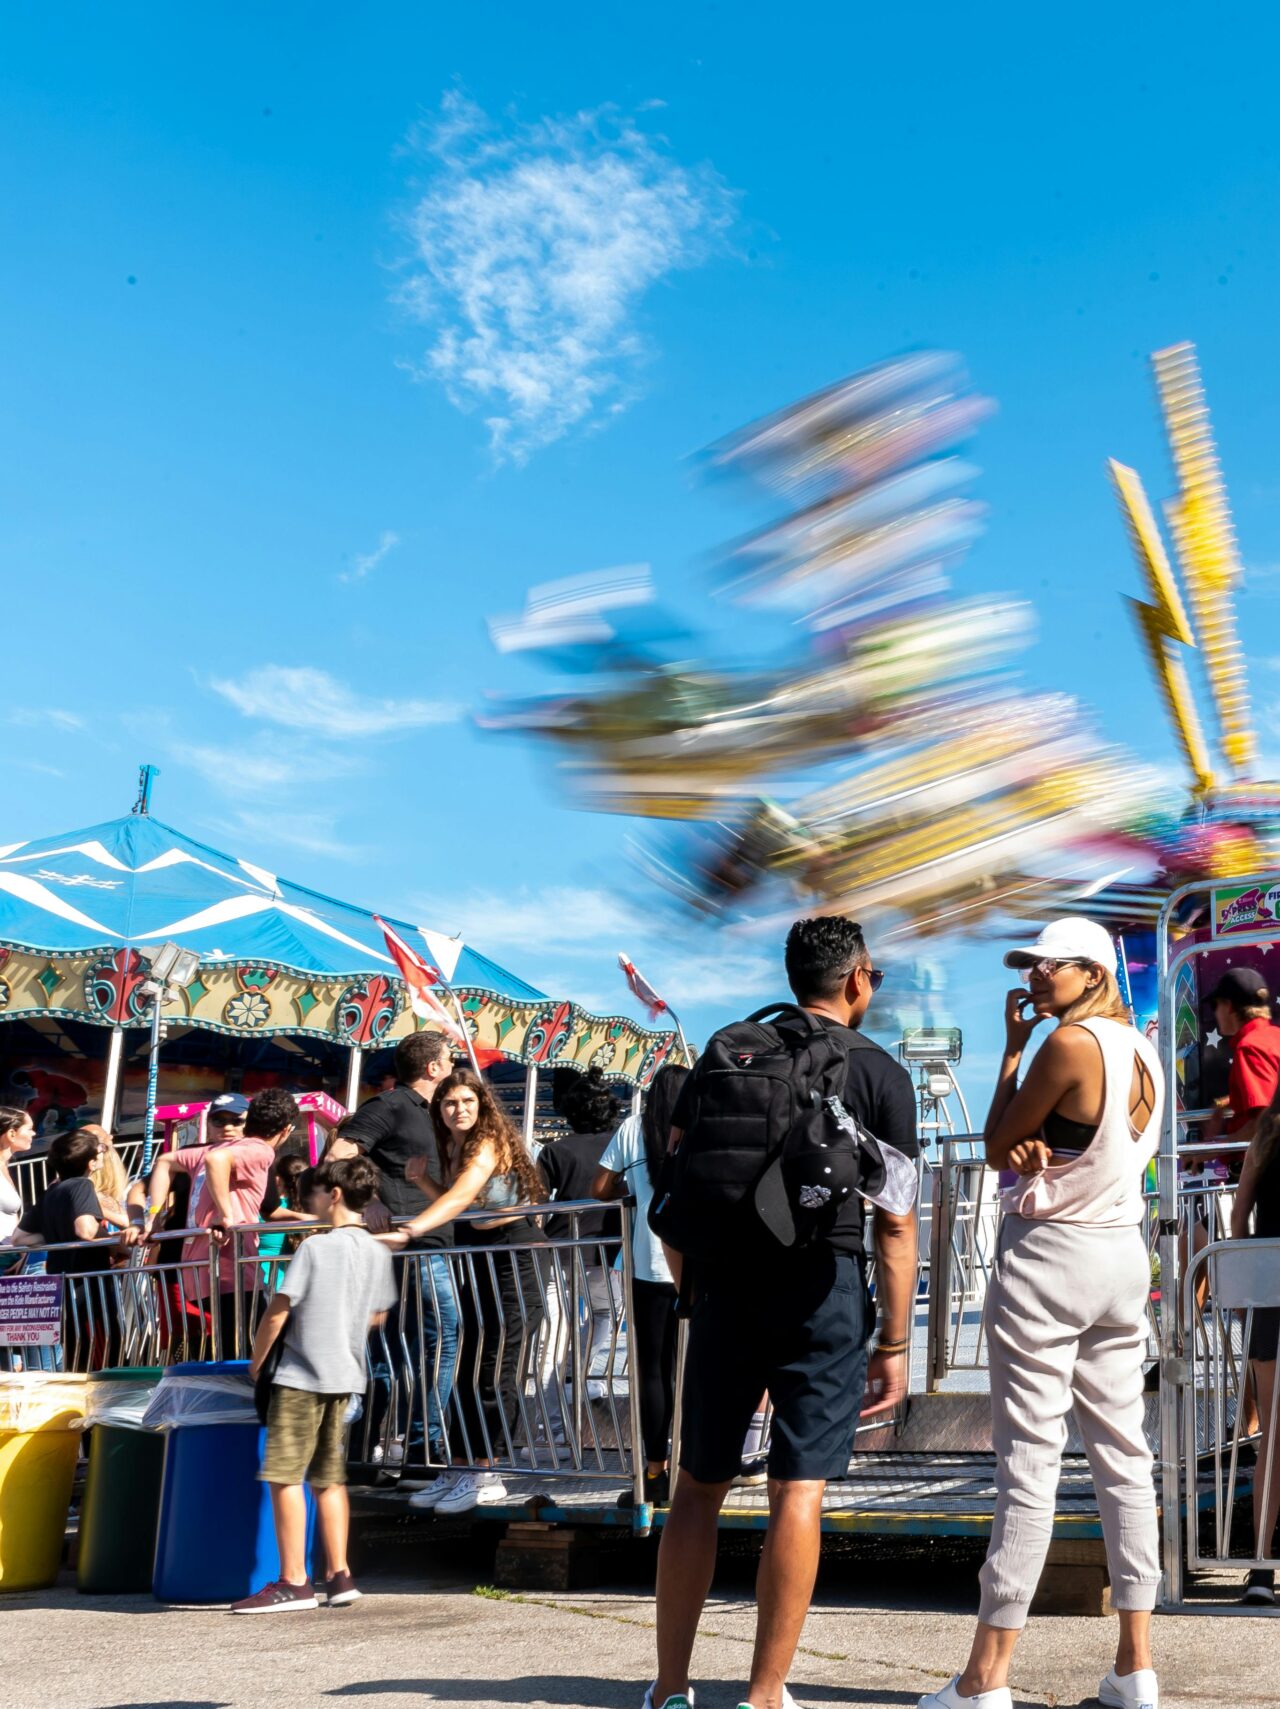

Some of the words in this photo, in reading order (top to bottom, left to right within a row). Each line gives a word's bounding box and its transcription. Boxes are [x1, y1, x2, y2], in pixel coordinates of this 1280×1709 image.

[1221, 902, 1257, 922] EXPRESS
[1230, 911, 1255, 923] ACCESS
[19, 1281, 33, 1295] Safety
[33, 1281, 57, 1291] Restraints
[15, 1294, 24, 1305] Ride
[25, 1293, 56, 1305] Manufacturer
[10, 1308, 28, 1319] PEOPLE
[28, 1307, 39, 1318] MAY
[39, 1307, 50, 1318] NOT
[51, 1306, 60, 1318] FIT
[7, 1332, 26, 1341] THANK
[27, 1332, 40, 1341] YOU
